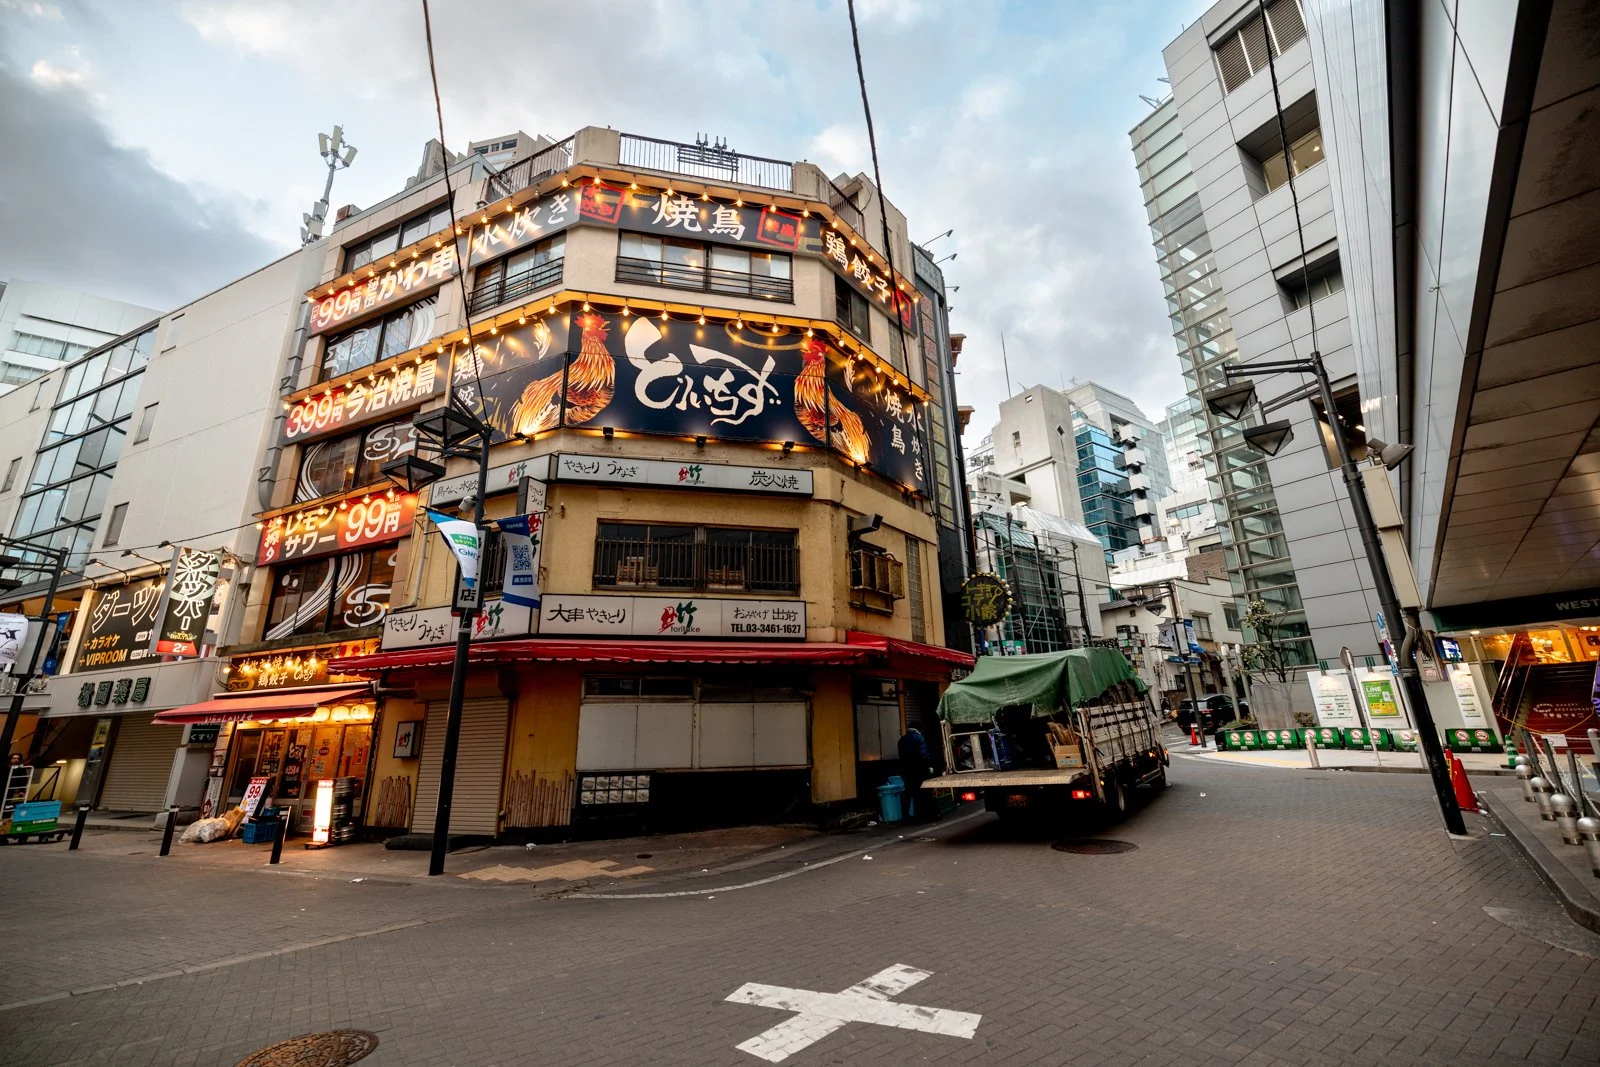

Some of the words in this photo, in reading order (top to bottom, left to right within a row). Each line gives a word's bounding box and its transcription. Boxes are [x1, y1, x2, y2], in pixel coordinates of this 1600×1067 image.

[471, 194, 570, 255] 水炊き
[651, 193, 746, 241] 焼鳥
[377, 244, 456, 302] かわ串
[826, 231, 891, 304] 鶏餃子
[453, 344, 485, 412] 鶏餃
[286, 396, 344, 438] 399円
[346, 359, 438, 419] 今治焼鳥
[884, 388, 905, 455] 焼鳥
[564, 460, 600, 474] やきとり
[607, 461, 639, 478] うなぎ
[749, 470, 800, 490] 炭火焼
[284, 507, 338, 537] レモン
[345, 498, 400, 543] 99円
[285, 531, 336, 558] サワー
[174, 551, 215, 631] ダーツバー
[1555, 598, 1600, 611] WEST
[92, 587, 162, 634] ダーツ
[547, 603, 626, 624] 大串やきとり
[734, 607, 770, 620] おみやげ
[772, 607, 798, 621] 出前
[389, 614, 418, 632] やきとり
[419, 620, 447, 642] うなぎ
[731, 623, 801, 634] TEL.03-3461-1627
[172, 643, 188, 653] 2F
[257, 672, 288, 687] 鶏餃子
[190, 733, 213, 741] くすり
